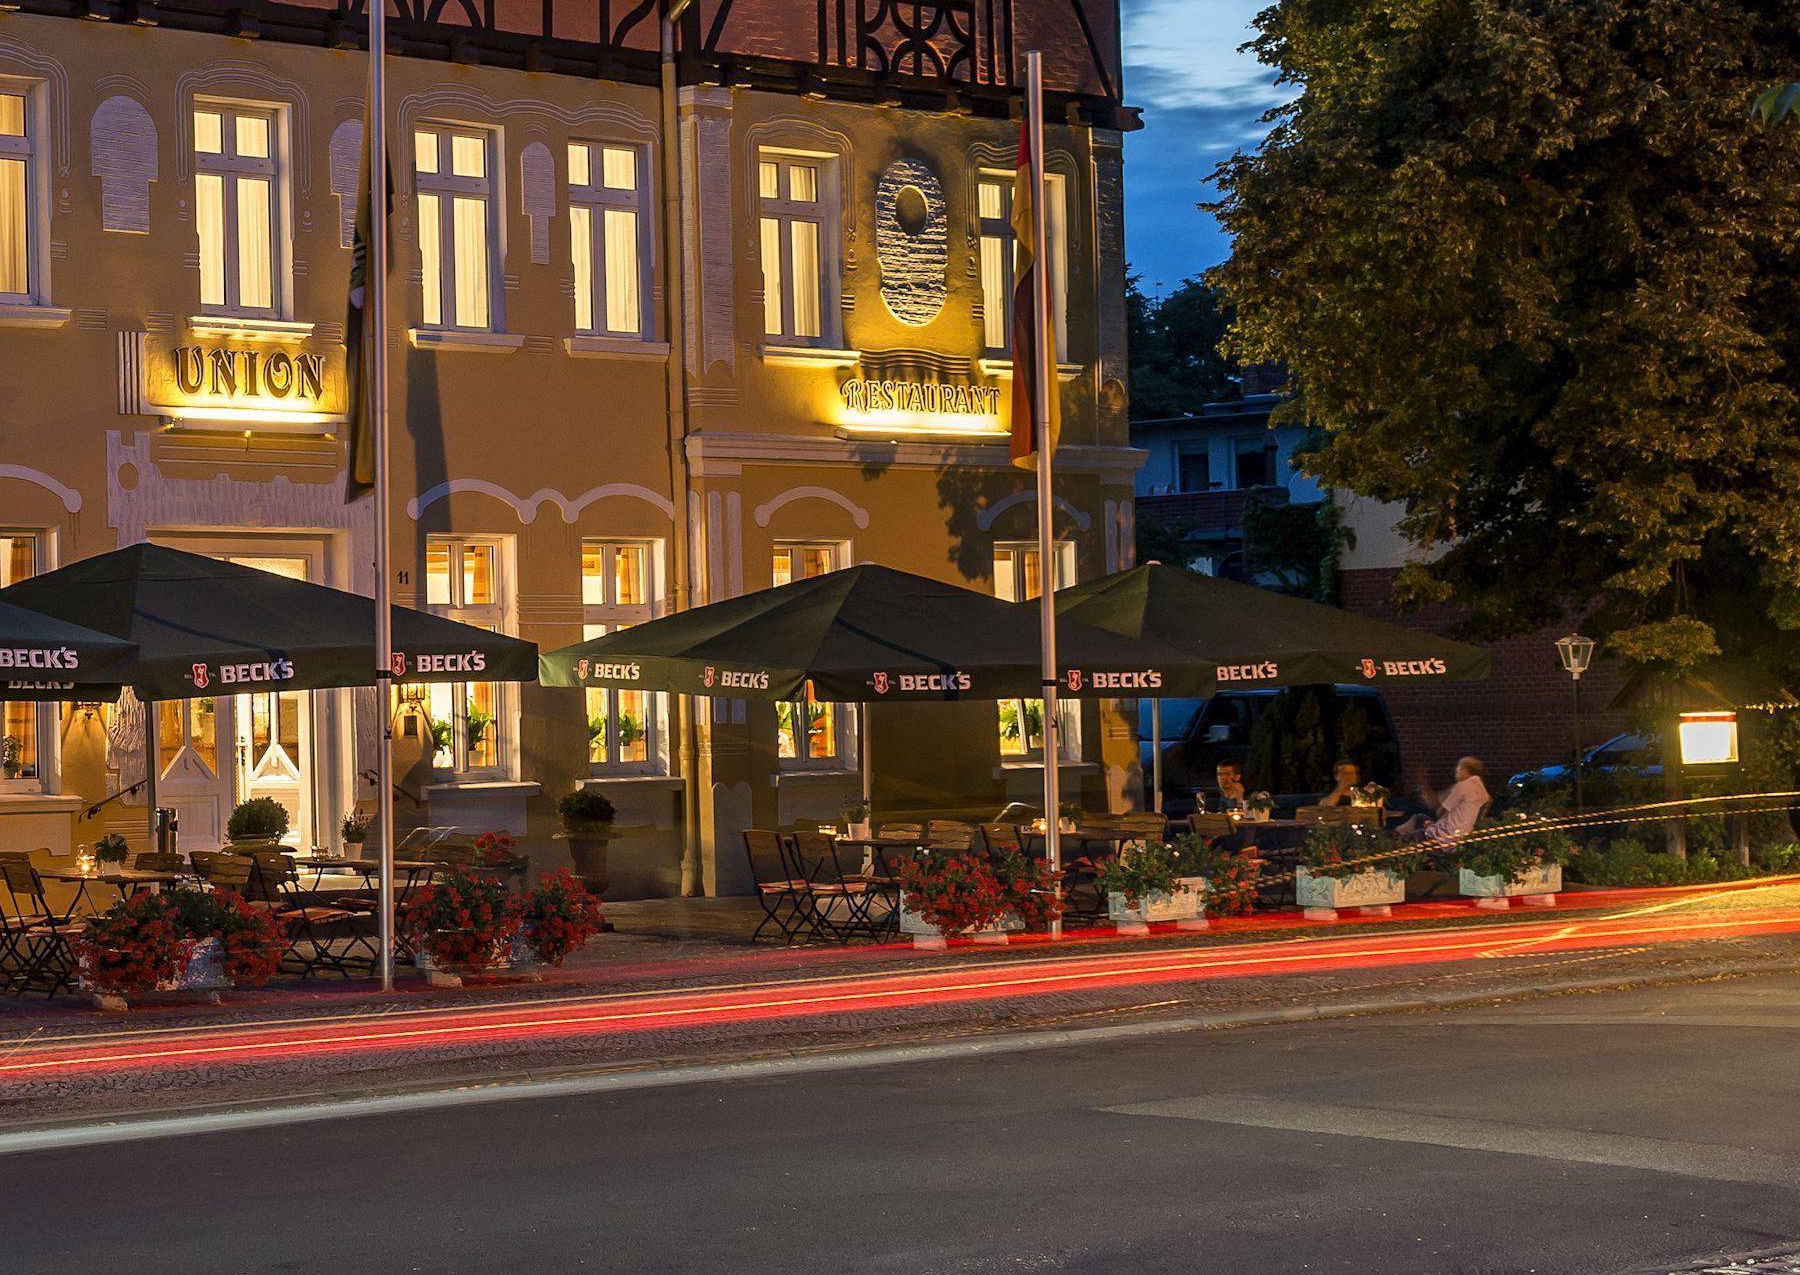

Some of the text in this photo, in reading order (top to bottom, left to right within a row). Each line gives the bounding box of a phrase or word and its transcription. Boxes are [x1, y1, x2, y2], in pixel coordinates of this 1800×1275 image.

[173, 345, 326, 401] UNION
[840, 377, 1002, 416] RESTAURANT
[396, 570, 409, 585] 11
[219, 658, 295, 684] BECK'S
[416, 650, 486, 673] BECK'S
[593, 662, 641, 681] BECK'S
[1216, 661, 1278, 681] BECK'S
[1383, 658, 1447, 676] BECK'S
[720, 670, 770, 690] BECK'S
[898, 670, 971, 691] BECK'S
[1092, 669, 1162, 689] BECK'S
